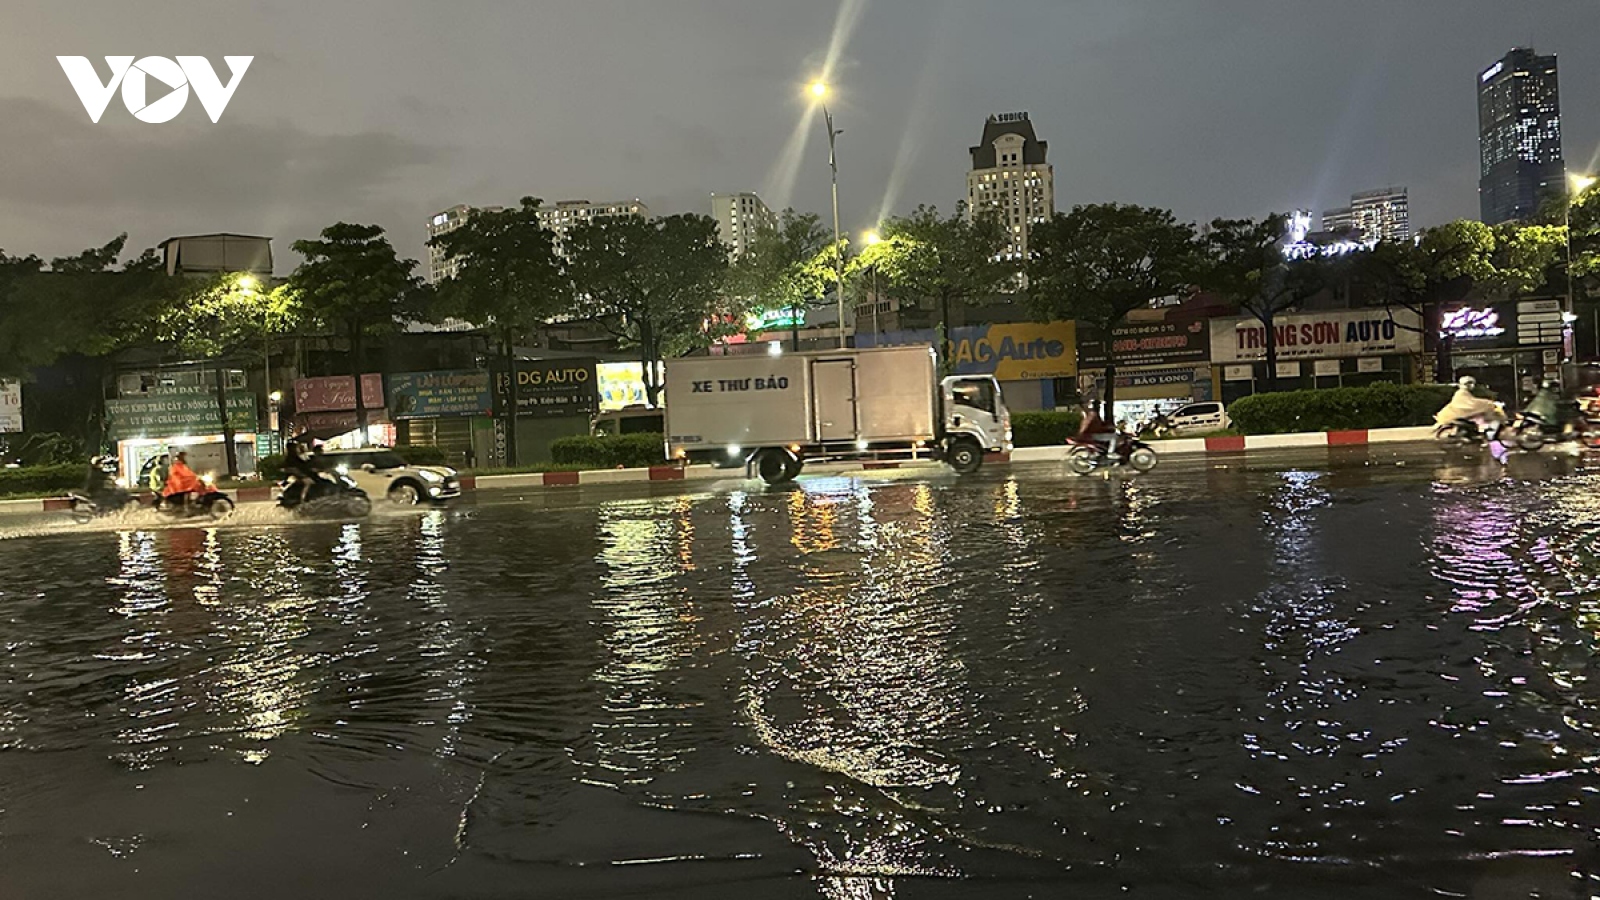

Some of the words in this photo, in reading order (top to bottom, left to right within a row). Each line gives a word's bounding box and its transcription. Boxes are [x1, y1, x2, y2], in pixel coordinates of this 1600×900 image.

[1300, 321, 1340, 345] SƠN
[1346, 319, 1396, 342] AUTO
[999, 336, 1064, 360] Auto
[517, 371, 541, 385] DG
[545, 368, 588, 383] AUTO
[1160, 374, 1189, 384] LONG
[692, 381, 713, 393] XE
[718, 378, 751, 392] THƯ
